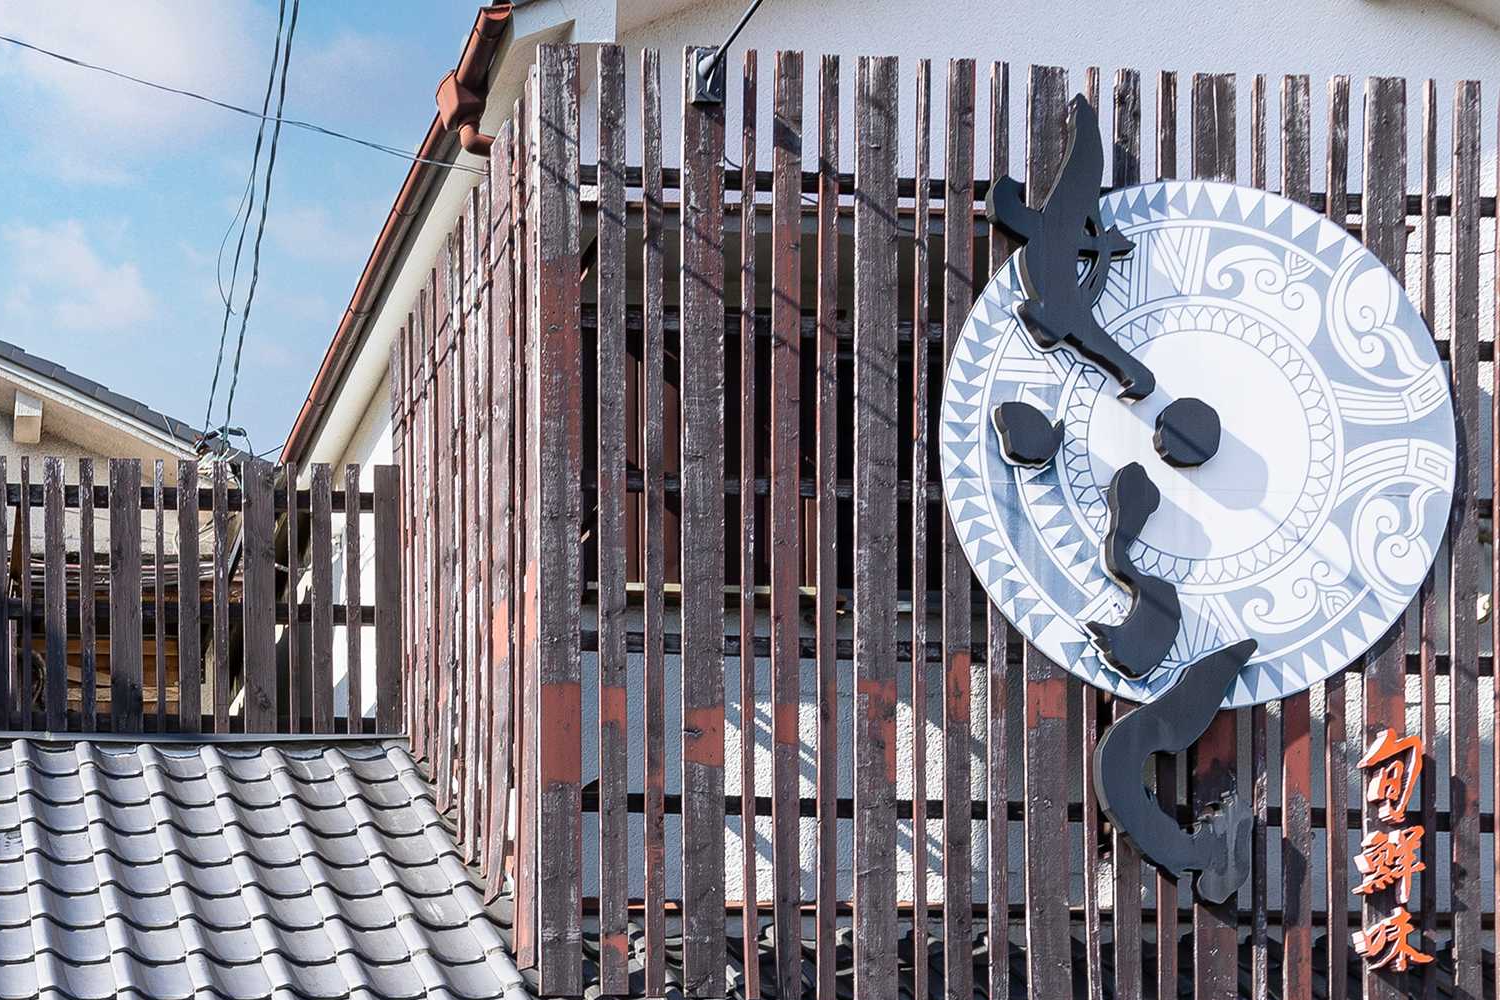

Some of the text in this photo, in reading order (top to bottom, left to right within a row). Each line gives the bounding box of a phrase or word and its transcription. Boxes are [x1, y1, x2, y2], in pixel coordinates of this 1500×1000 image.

[985, 93, 1258, 906] きらく
[1351, 727, 1436, 972] 旬鮮味
